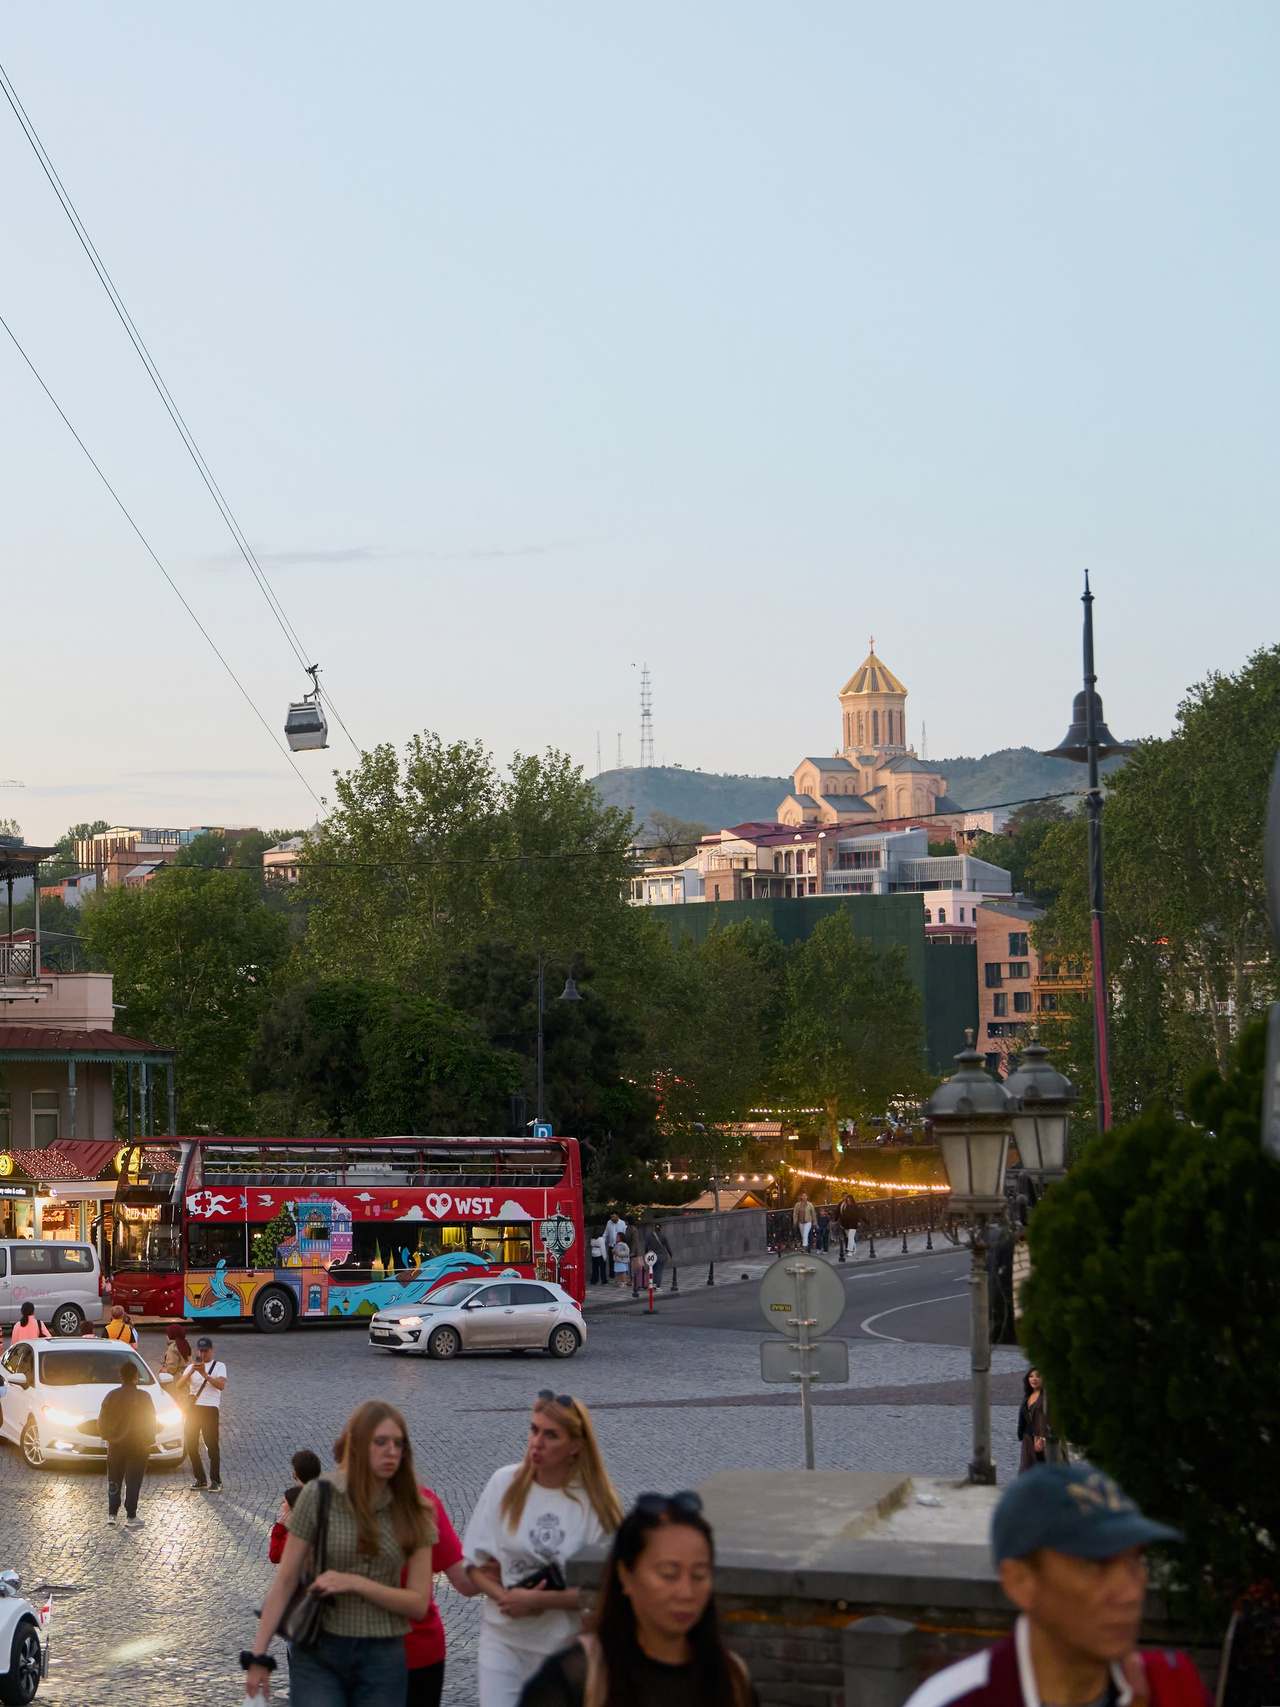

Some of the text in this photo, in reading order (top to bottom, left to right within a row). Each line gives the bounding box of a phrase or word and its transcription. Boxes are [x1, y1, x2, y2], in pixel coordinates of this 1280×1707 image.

[125, 1207, 158, 1220] RED LINE
[454, 1197, 494, 1215] WST
